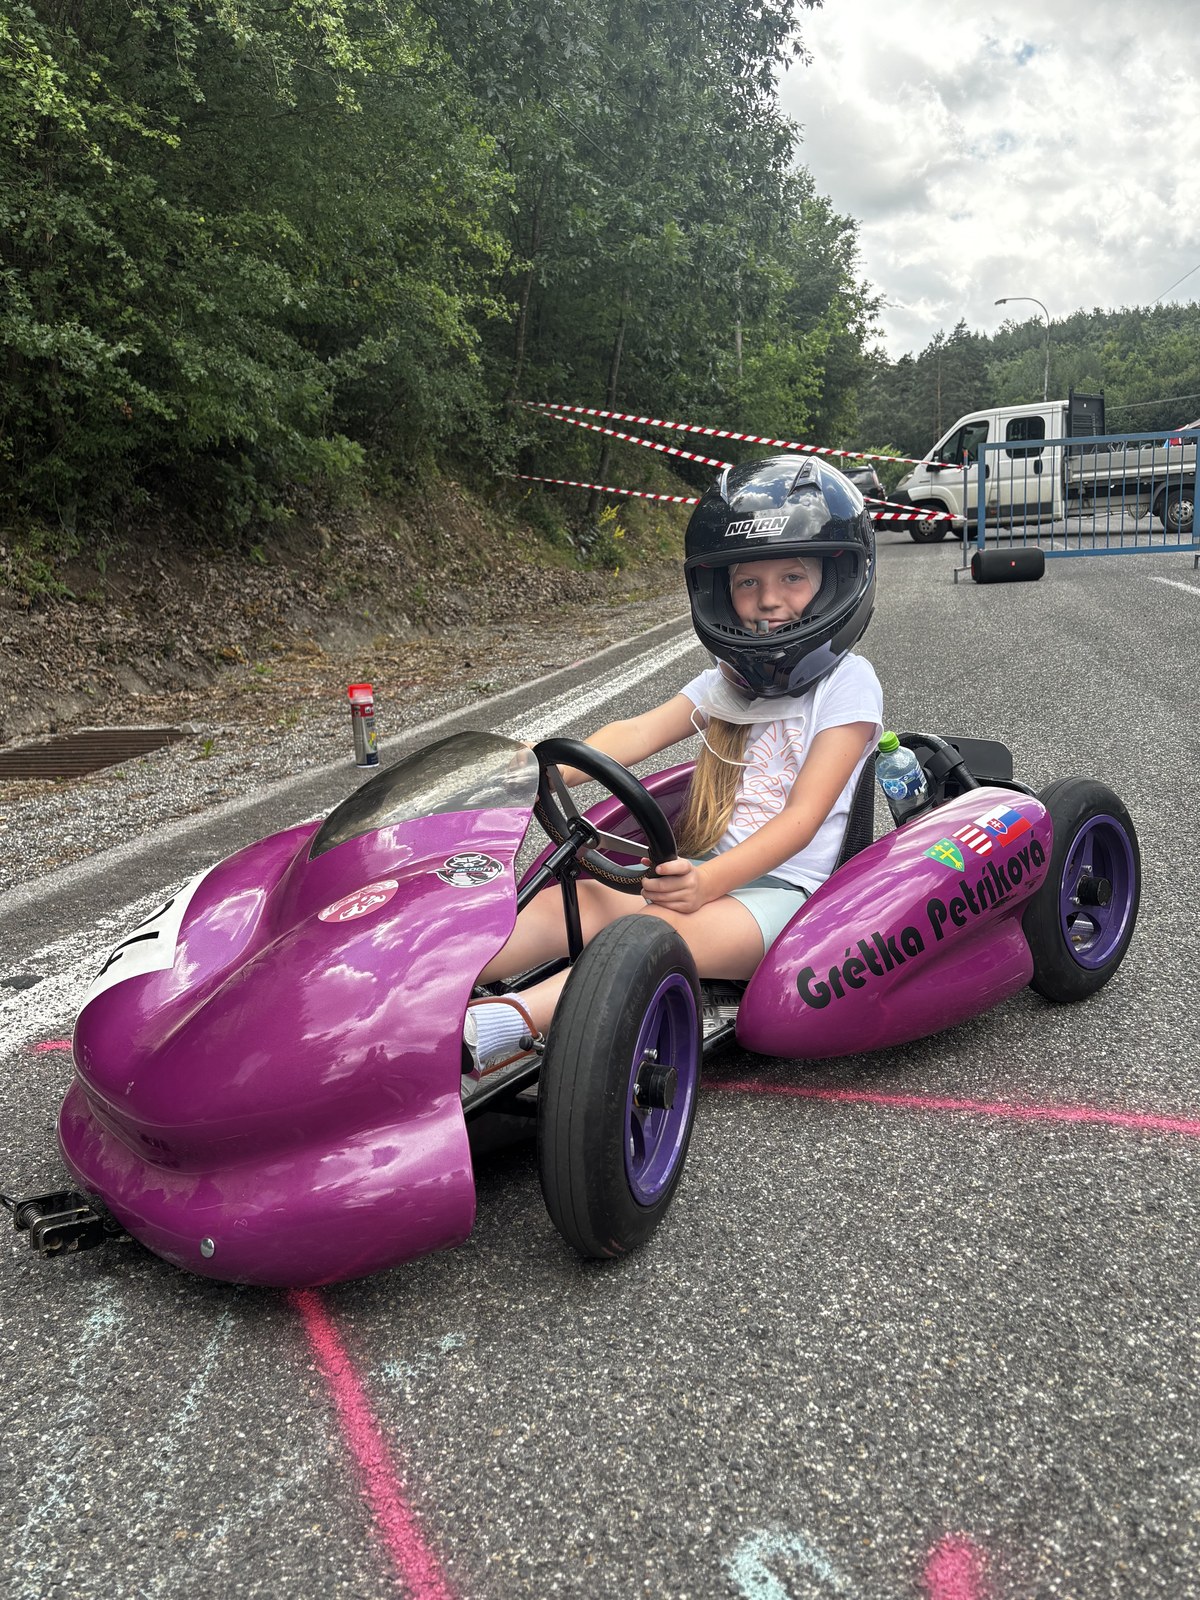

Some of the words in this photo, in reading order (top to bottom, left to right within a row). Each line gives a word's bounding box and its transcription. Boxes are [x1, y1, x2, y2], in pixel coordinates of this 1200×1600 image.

[725, 516, 790, 539] NOLAN
[796, 931, 925, 1009] Grétka
[926, 832, 1046, 942] Petríková
